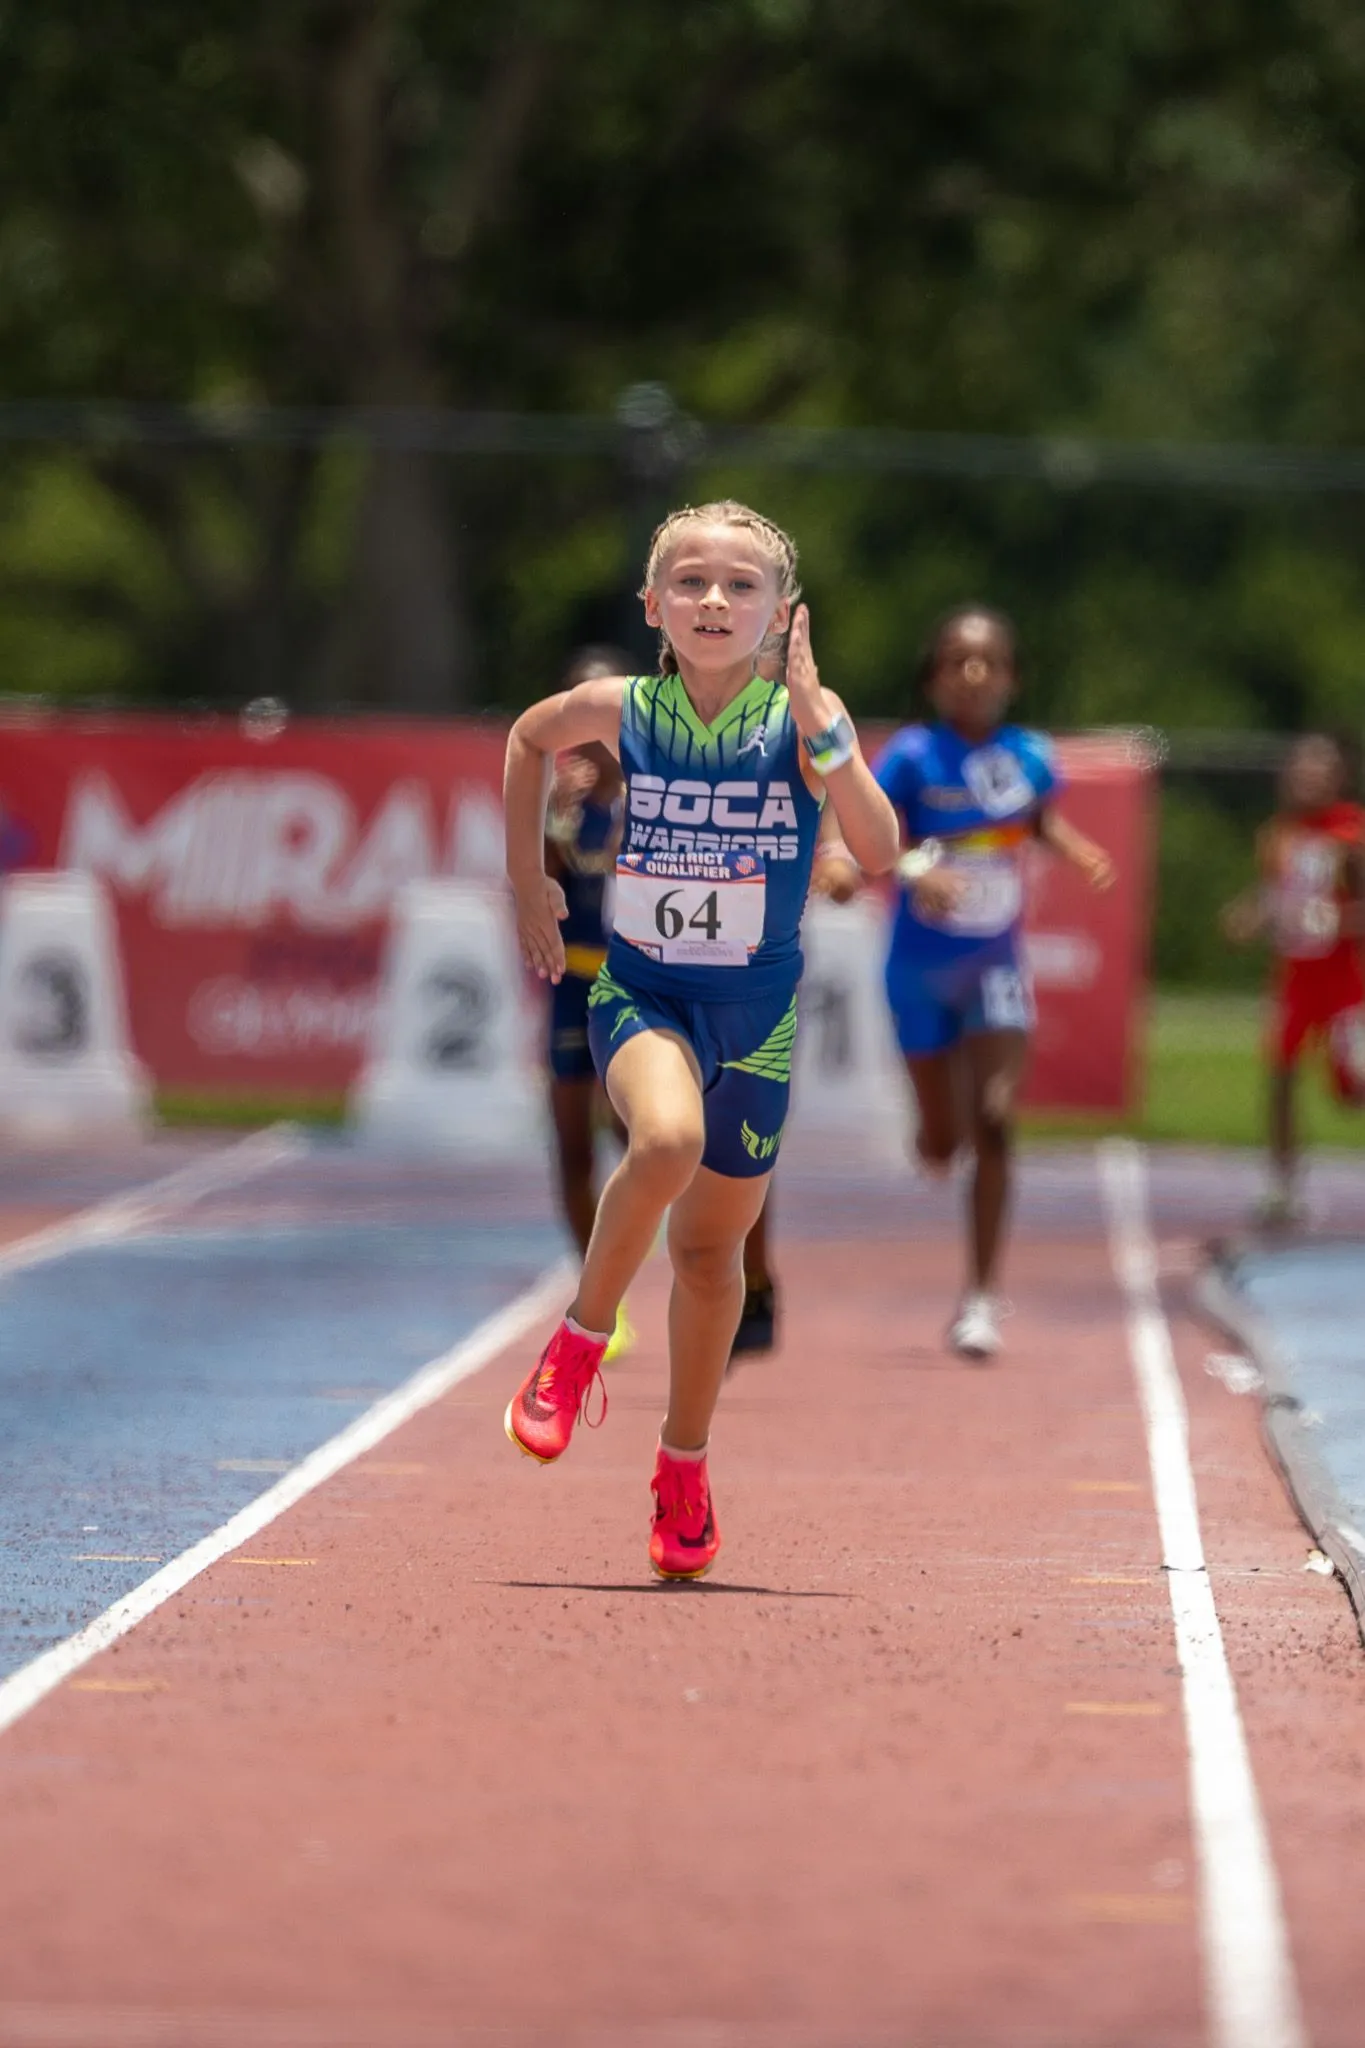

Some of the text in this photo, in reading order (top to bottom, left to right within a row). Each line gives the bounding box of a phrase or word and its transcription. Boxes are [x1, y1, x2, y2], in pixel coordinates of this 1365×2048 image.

[630, 773, 798, 829] BOCA
[630, 821, 799, 861] WARRIORS
[652, 851, 725, 865] DISTRICT
[646, 860, 731, 879] QUALIFIER
[655, 888, 722, 940] 64
[14, 950, 88, 1066] 3
[415, 960, 492, 1076] 2
